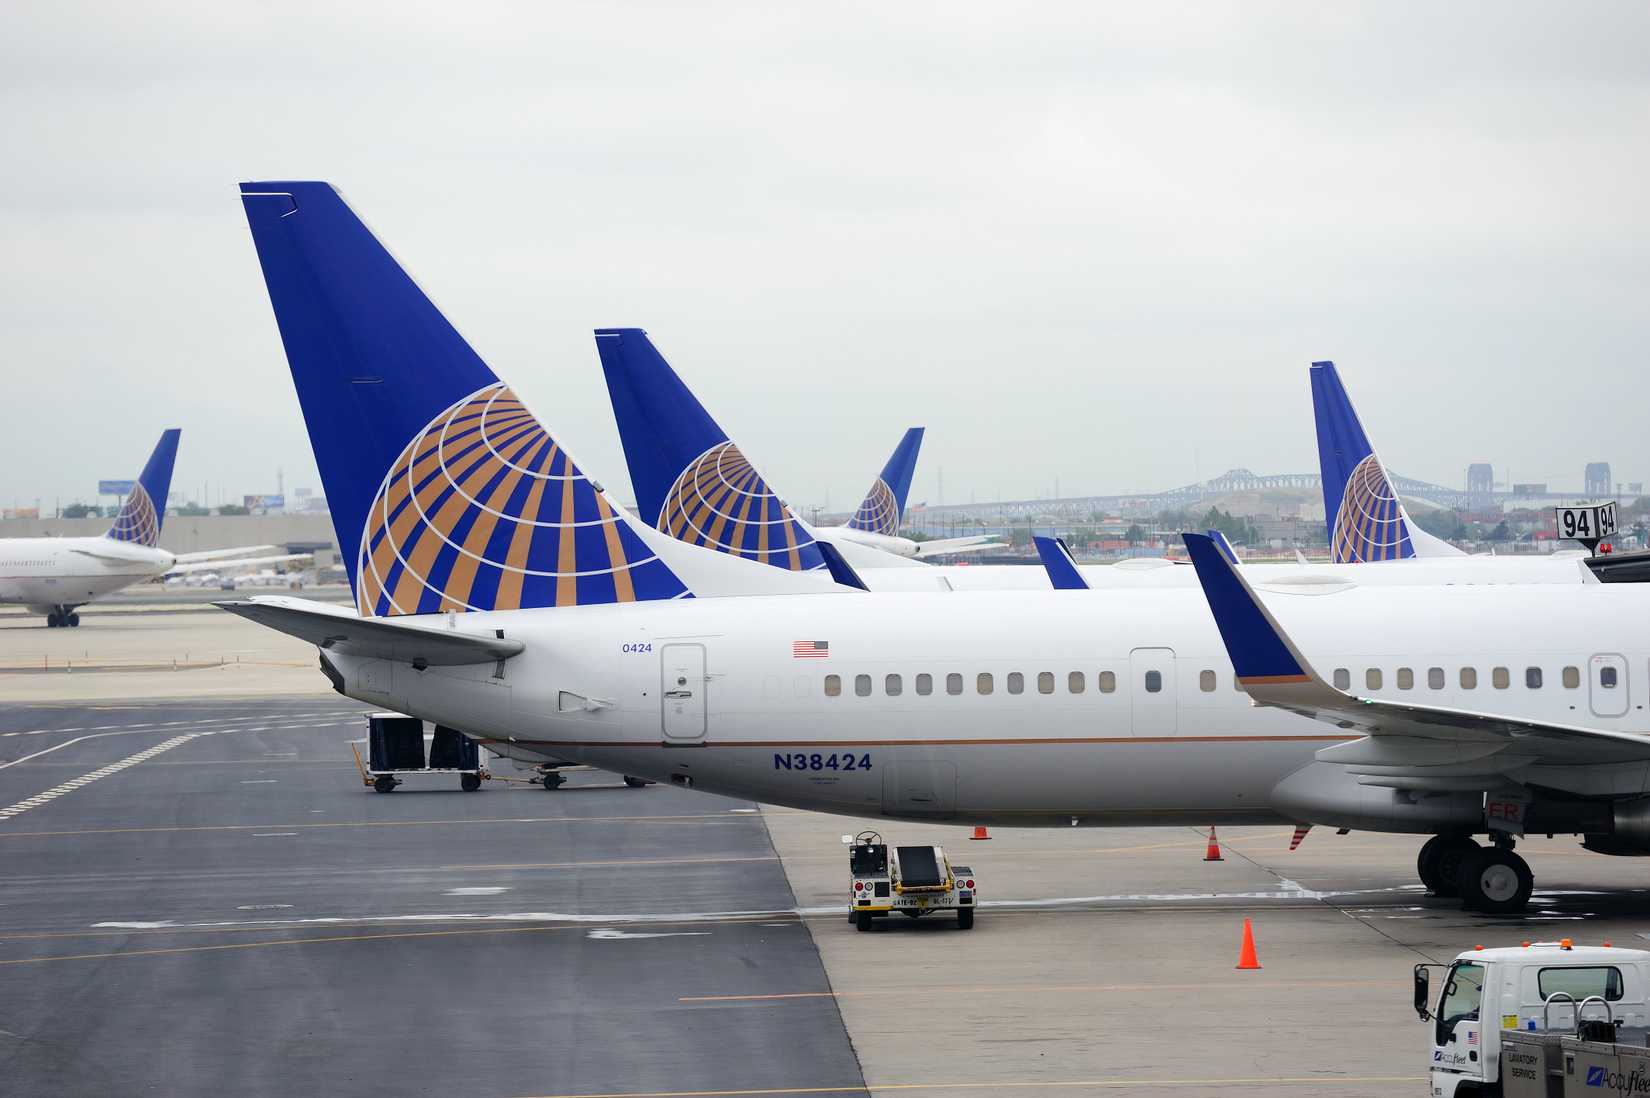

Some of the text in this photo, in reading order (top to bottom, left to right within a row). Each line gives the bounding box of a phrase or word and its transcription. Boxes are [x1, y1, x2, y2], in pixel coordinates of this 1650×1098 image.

[1563, 510, 1590, 537] 94
[1601, 505, 1614, 535] 94
[622, 643, 652, 653] 0424
[774, 753, 872, 771] N38424
[1508, 1053, 1538, 1065] LAVATORY
[1512, 1068, 1537, 1080] SERVICE
